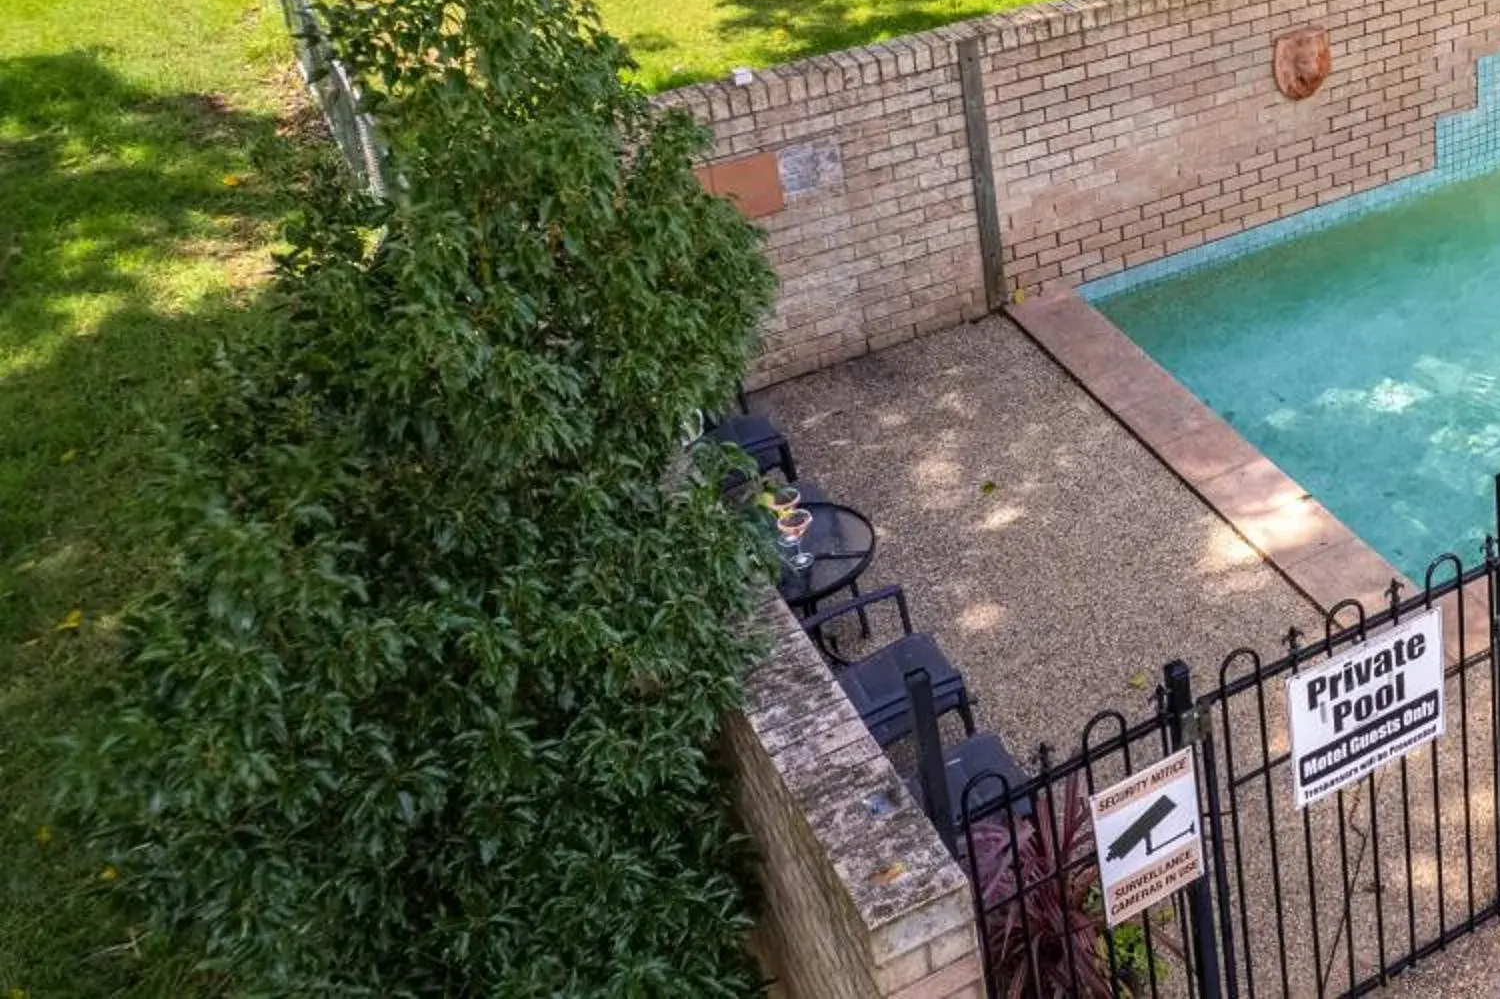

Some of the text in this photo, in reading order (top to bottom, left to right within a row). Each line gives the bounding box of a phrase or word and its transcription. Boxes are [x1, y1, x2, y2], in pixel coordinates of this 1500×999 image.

[1307, 632, 1426, 711] Private
[1333, 671, 1405, 733] Pool
[1303, 699, 1436, 779] Motel Guests Only
[1098, 756, 1187, 812] SECURITY NOTICE
[1111, 881, 1163, 915] CAMERAS
[1165, 873, 1177, 885] IN
[1115, 849, 1192, 899] SURVEILLANCE
